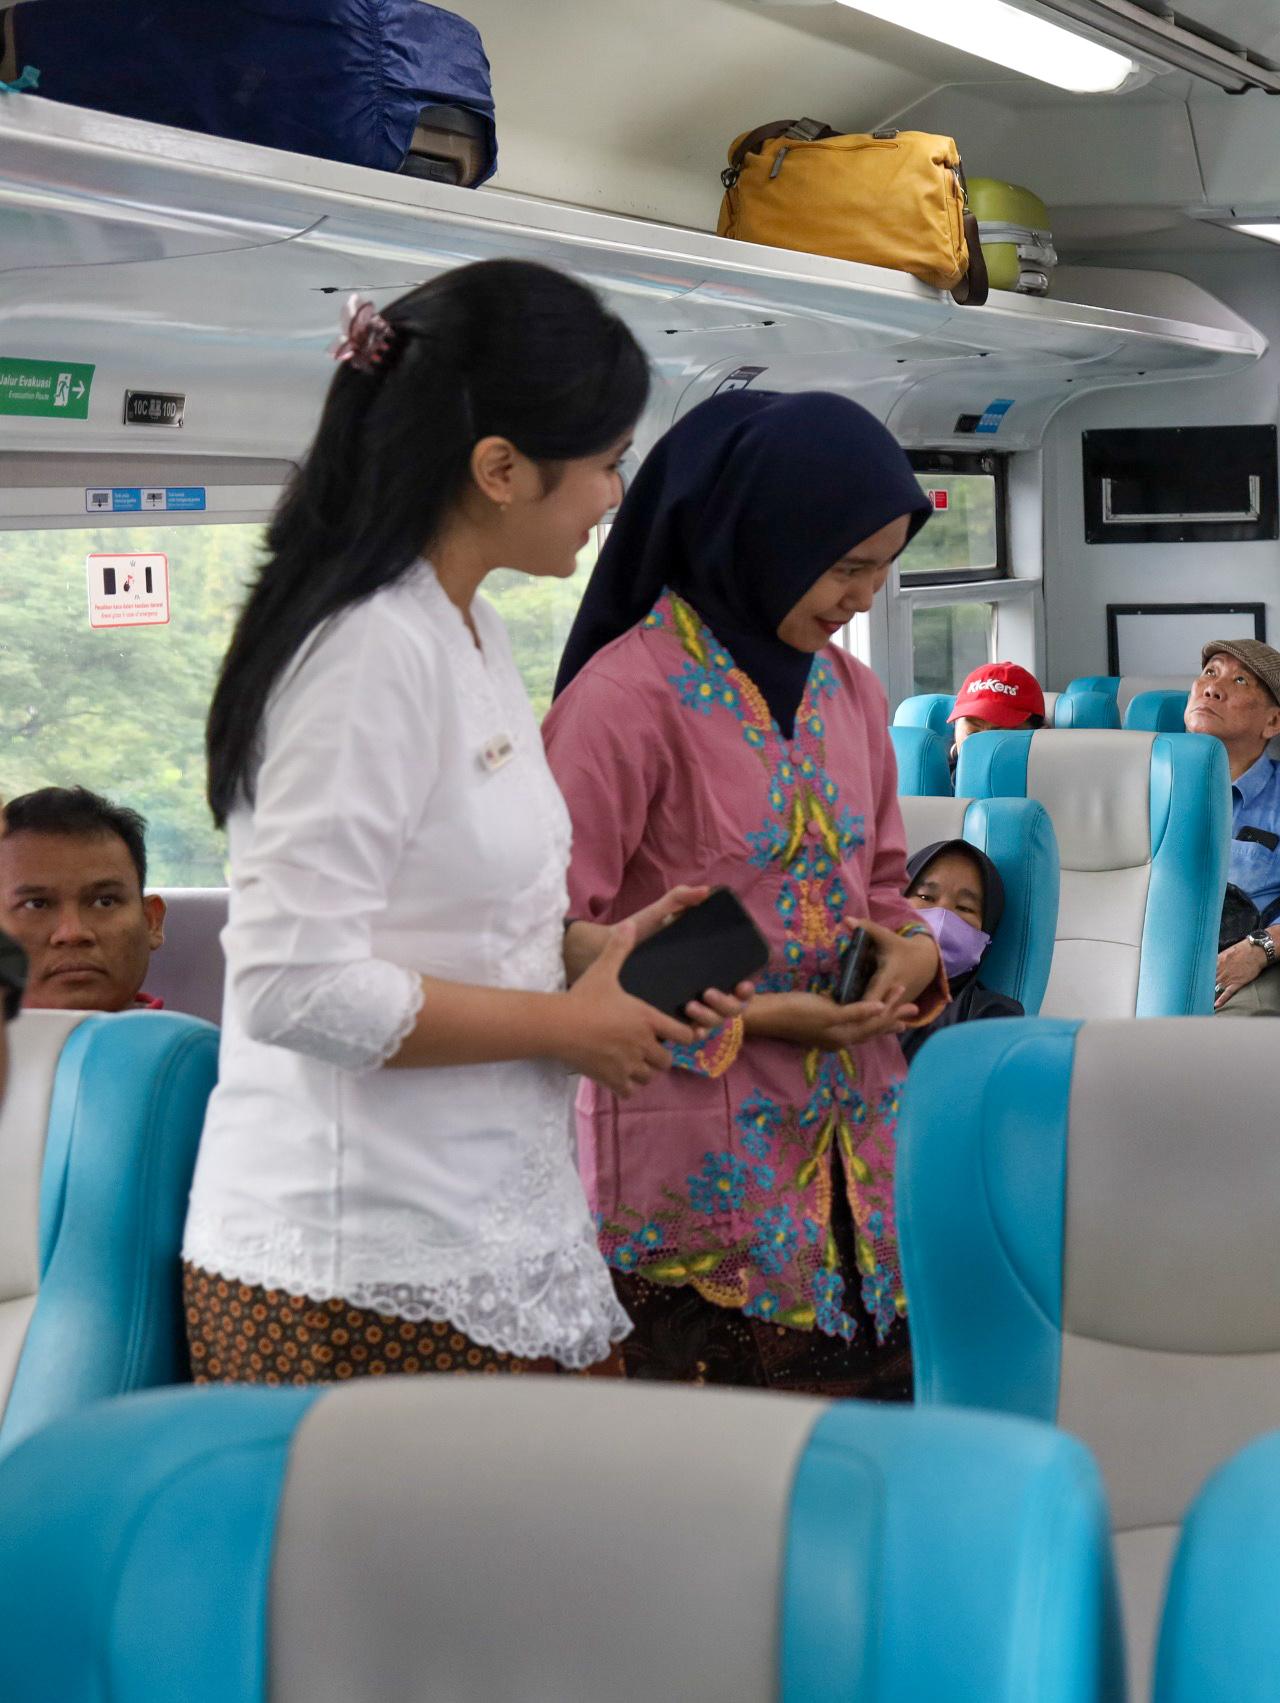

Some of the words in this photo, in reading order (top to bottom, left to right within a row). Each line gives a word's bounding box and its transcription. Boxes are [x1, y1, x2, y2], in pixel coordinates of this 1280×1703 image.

[19, 375, 52, 388] Evakuasi
[133, 400, 148, 415] 10C
[162, 403, 177, 417] 10D
